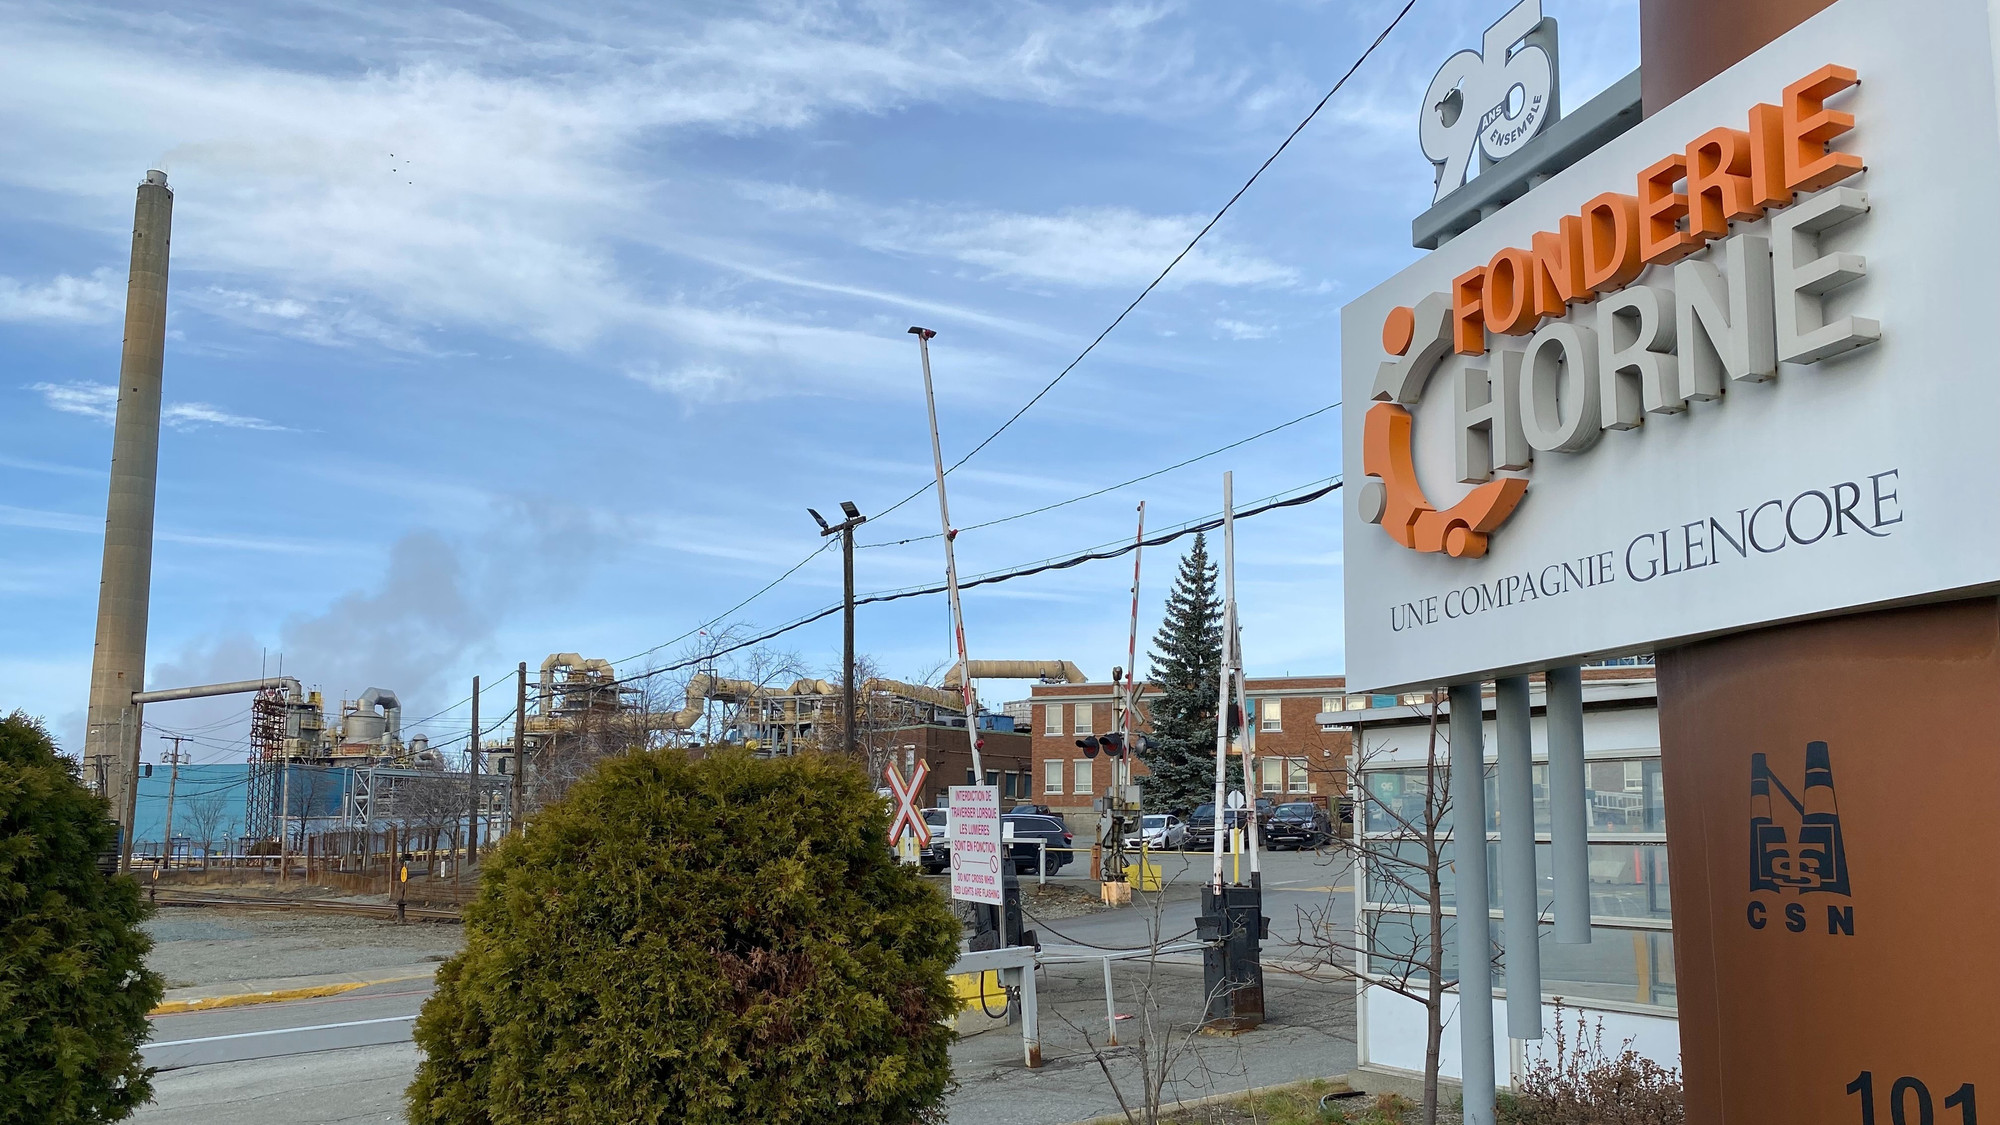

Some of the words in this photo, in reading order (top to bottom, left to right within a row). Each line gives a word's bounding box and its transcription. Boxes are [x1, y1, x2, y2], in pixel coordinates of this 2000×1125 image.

[1420, 0, 1553, 207] 95
[1480, 105, 1503, 130] ANS
[1489, 93, 1543, 147] ENSEMBLE
[1452, 63, 1864, 357] FONDERIE
[1454, 186, 1882, 485] HORNE
[1390, 595, 1439, 632] UNE
[1444, 550, 1616, 619] COMPAGNIE
[1625, 468, 1904, 583] GLENCORE
[955, 790, 985, 801] INTERDICTION
[985, 790, 992, 802] DE
[951, 806, 976, 818] TRAVERSER
[976, 807, 997, 819] LORSQUE
[959, 823, 968, 835] LES
[954, 839, 966, 851] SONT
[966, 840, 973, 852] EN
[973, 841, 996, 853] FONCTION
[957, 872, 963, 882] DO
[963, 873, 971, 883] NOT
[971, 874, 984, 884] CROSS
[984, 875, 995, 885] WHEN
[953, 885, 961, 895] RED
[961, 886, 974, 896] LIGHTS
[974, 887, 982, 897] ARE
[982, 888, 1000, 899] FLASHING
[1846, 1070, 1978, 1125] 101
